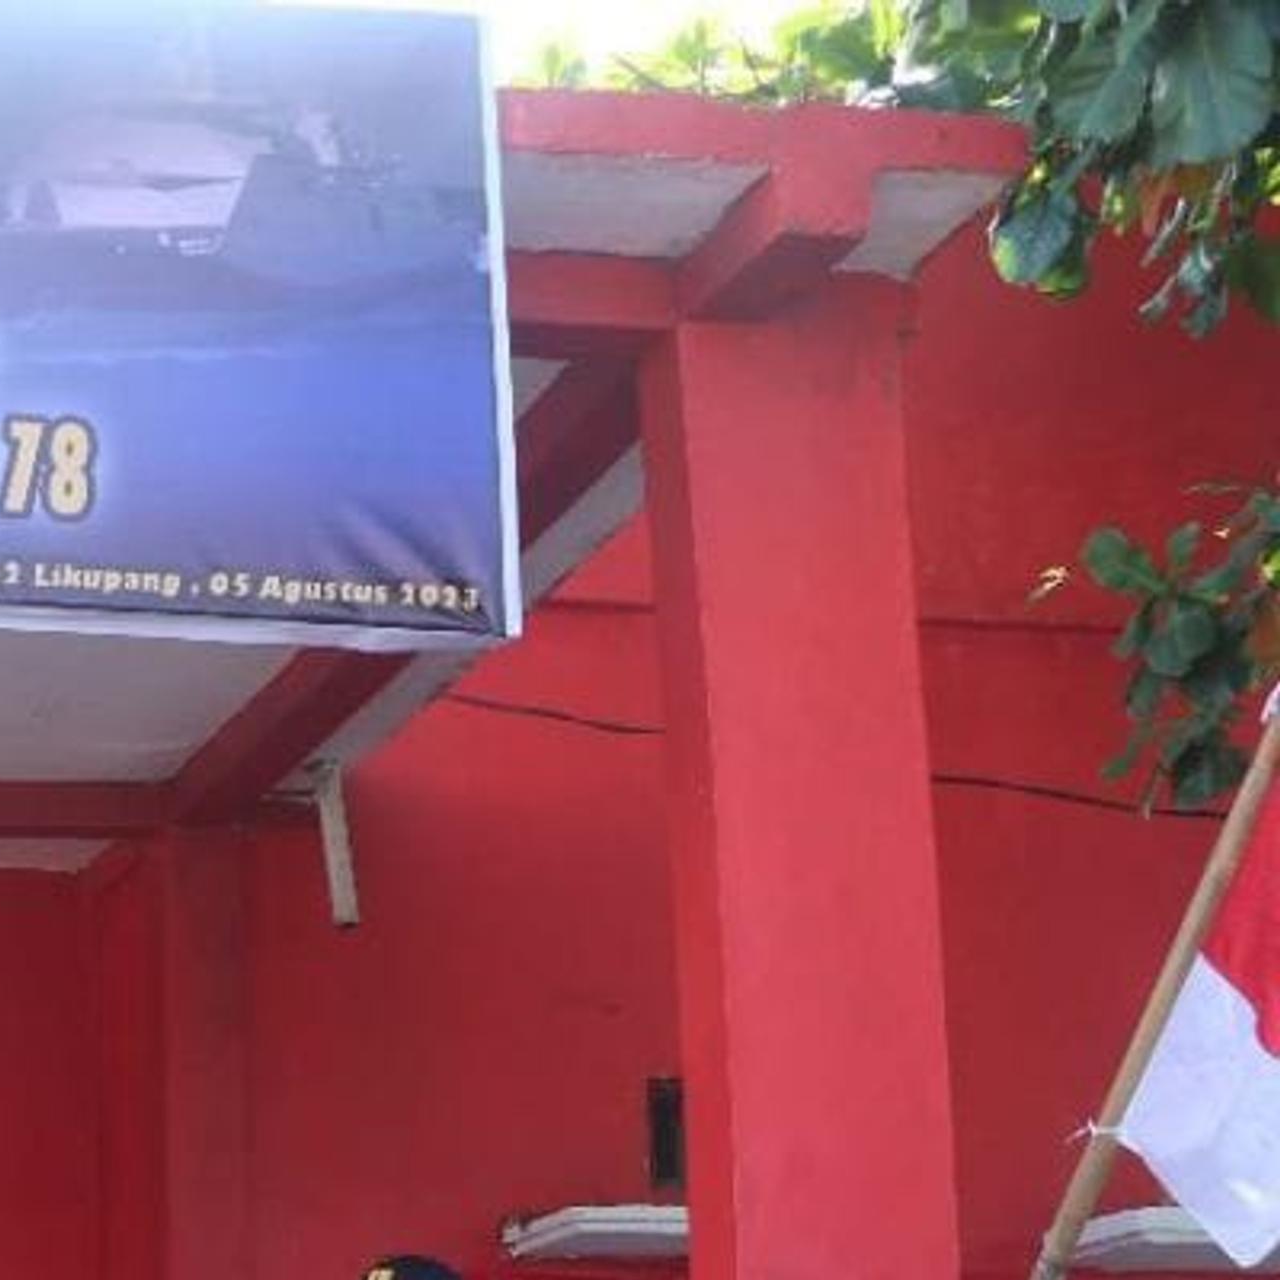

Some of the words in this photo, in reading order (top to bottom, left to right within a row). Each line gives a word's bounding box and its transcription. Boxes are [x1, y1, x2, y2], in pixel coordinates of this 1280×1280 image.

[2, 561, 22, 584] 2
[34, 562, 180, 598] Likupang
[209, 573, 250, 596] 05
[258, 575, 387, 606] Agustus
